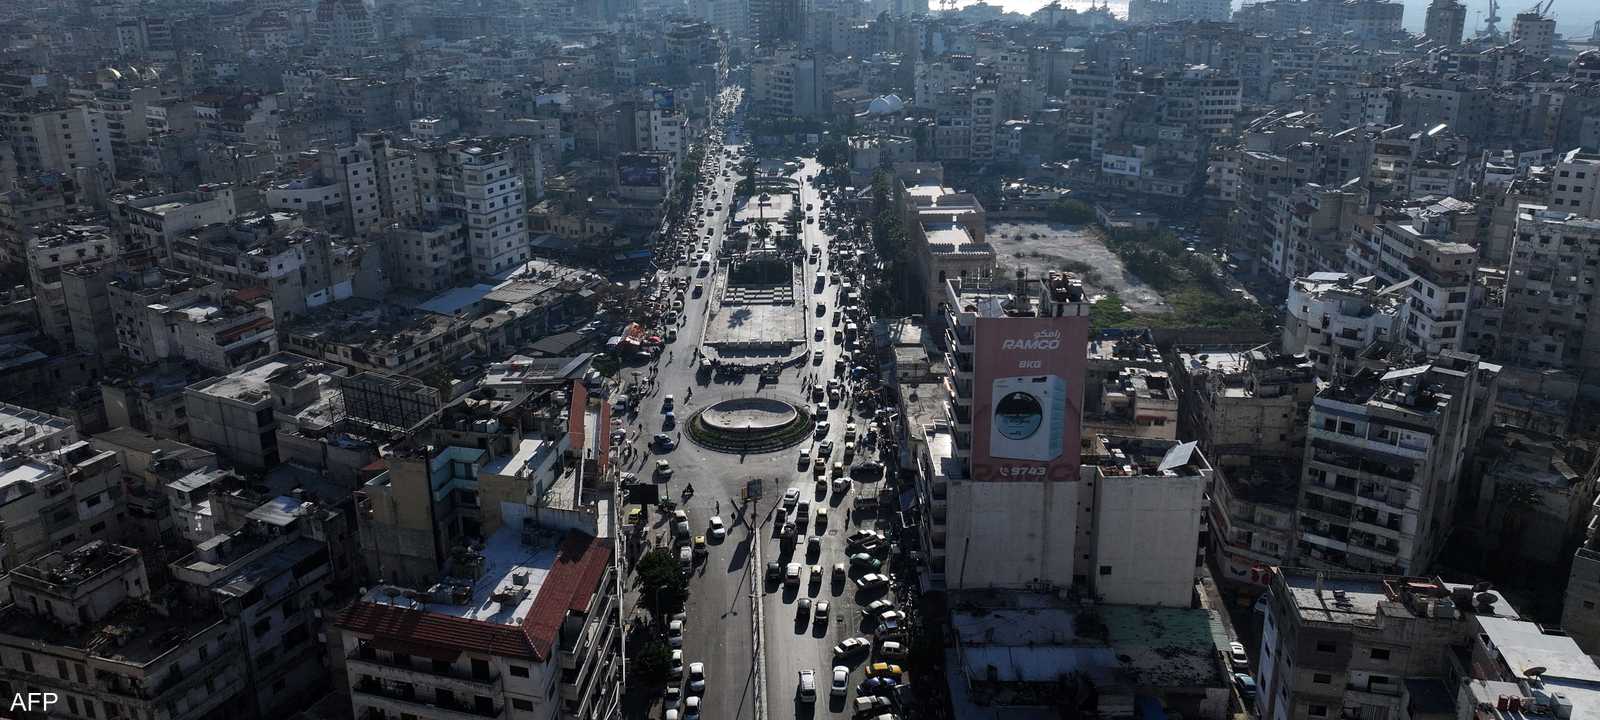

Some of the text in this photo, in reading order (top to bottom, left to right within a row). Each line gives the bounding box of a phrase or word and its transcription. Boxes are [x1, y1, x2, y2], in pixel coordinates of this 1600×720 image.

[1033, 329, 1061, 339] رامكو
[1002, 339, 1061, 350] RAMCO
[1010, 466, 1047, 476] 9743
